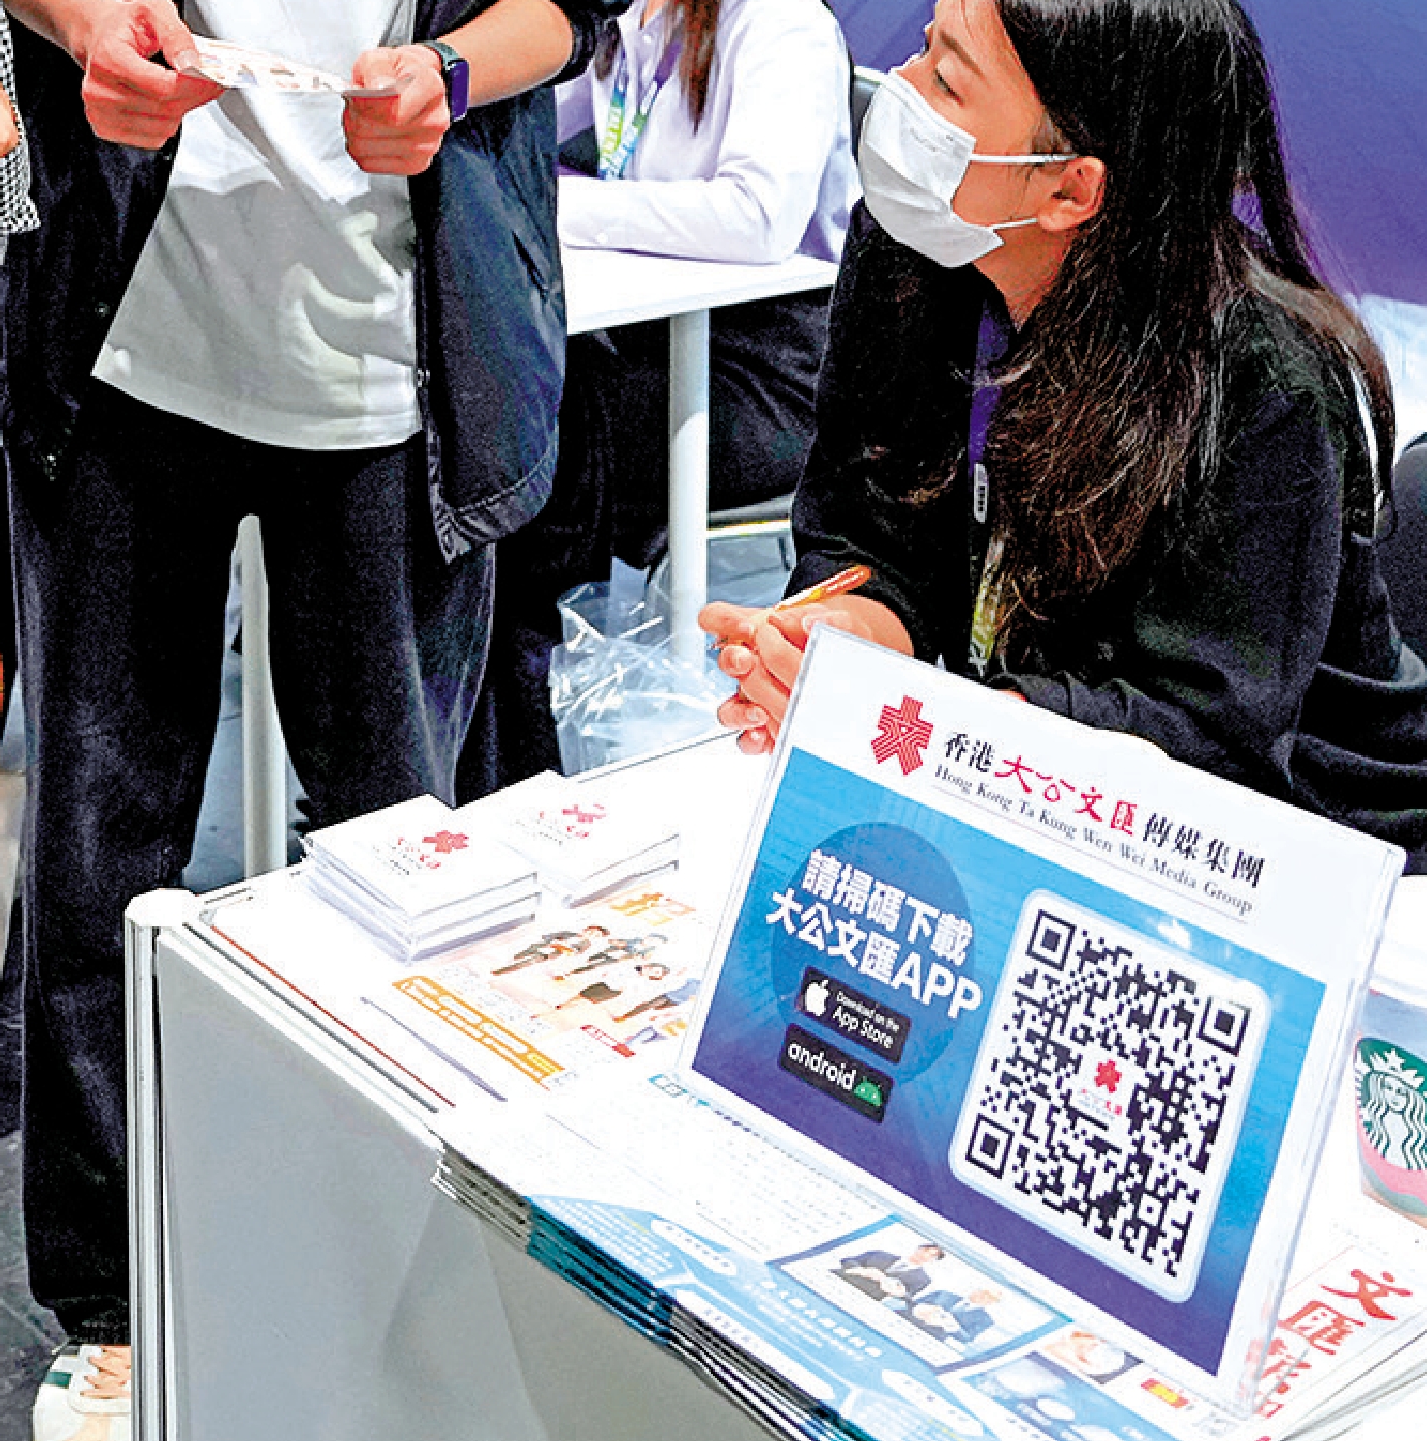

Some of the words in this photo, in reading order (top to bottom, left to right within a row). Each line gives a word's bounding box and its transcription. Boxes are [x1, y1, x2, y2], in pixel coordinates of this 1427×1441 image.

[935, 764, 973, 794] Hong
[976, 783, 1013, 812] Kong
[1040, 810, 1078, 840] Kung
[1083, 827, 1113, 853] Wen
[1119, 842, 1147, 868] Wei
[1150, 857, 1197, 889] Media
[1203, 881, 1253, 917] Group
[765, 888, 983, 1019] 大公文匯APP
[802, 848, 973, 966] 請掃碼下載
[788, 1042, 857, 1092] android
[833, 1006, 859, 1032] App
[860, 1018, 894, 1049] Store
